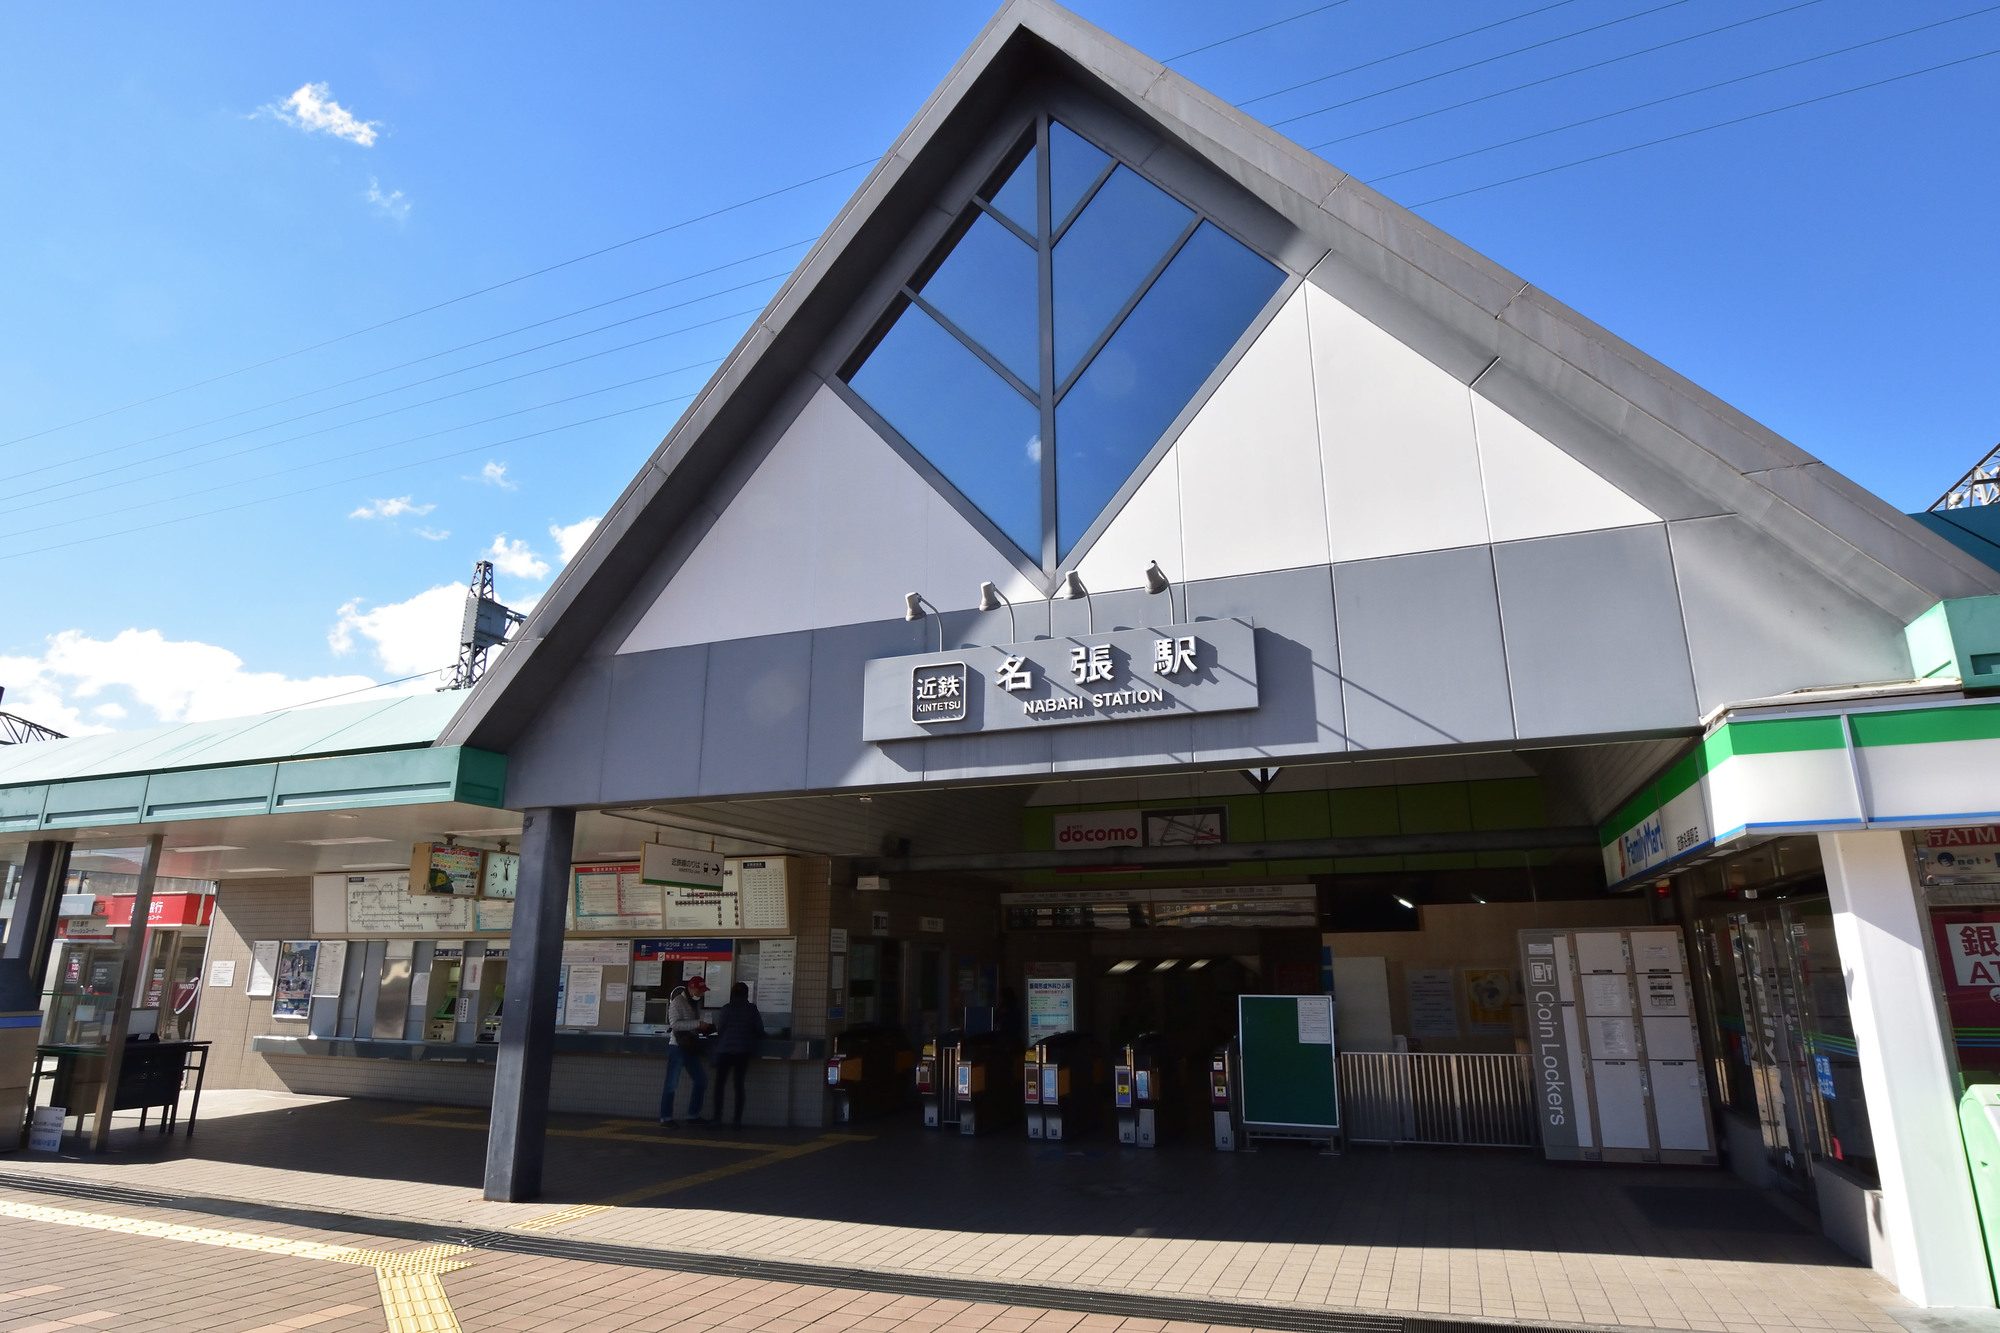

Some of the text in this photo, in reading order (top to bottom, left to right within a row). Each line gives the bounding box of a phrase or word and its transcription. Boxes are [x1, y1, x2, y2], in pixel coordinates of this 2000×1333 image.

[995, 635, 1198, 692] 名張駅
[916, 675, 960, 700] 近鉄
[916, 700, 961, 712] KINTETSU
[1024, 688, 1164, 714] NABARI STATION
[1059, 826, 1138, 843] docomo
[1624, 818, 1664, 868] FamilyMart
[671, 858, 700, 868] 近鉄線のりば
[1535, 991, 1564, 1126] Coin Lockers
